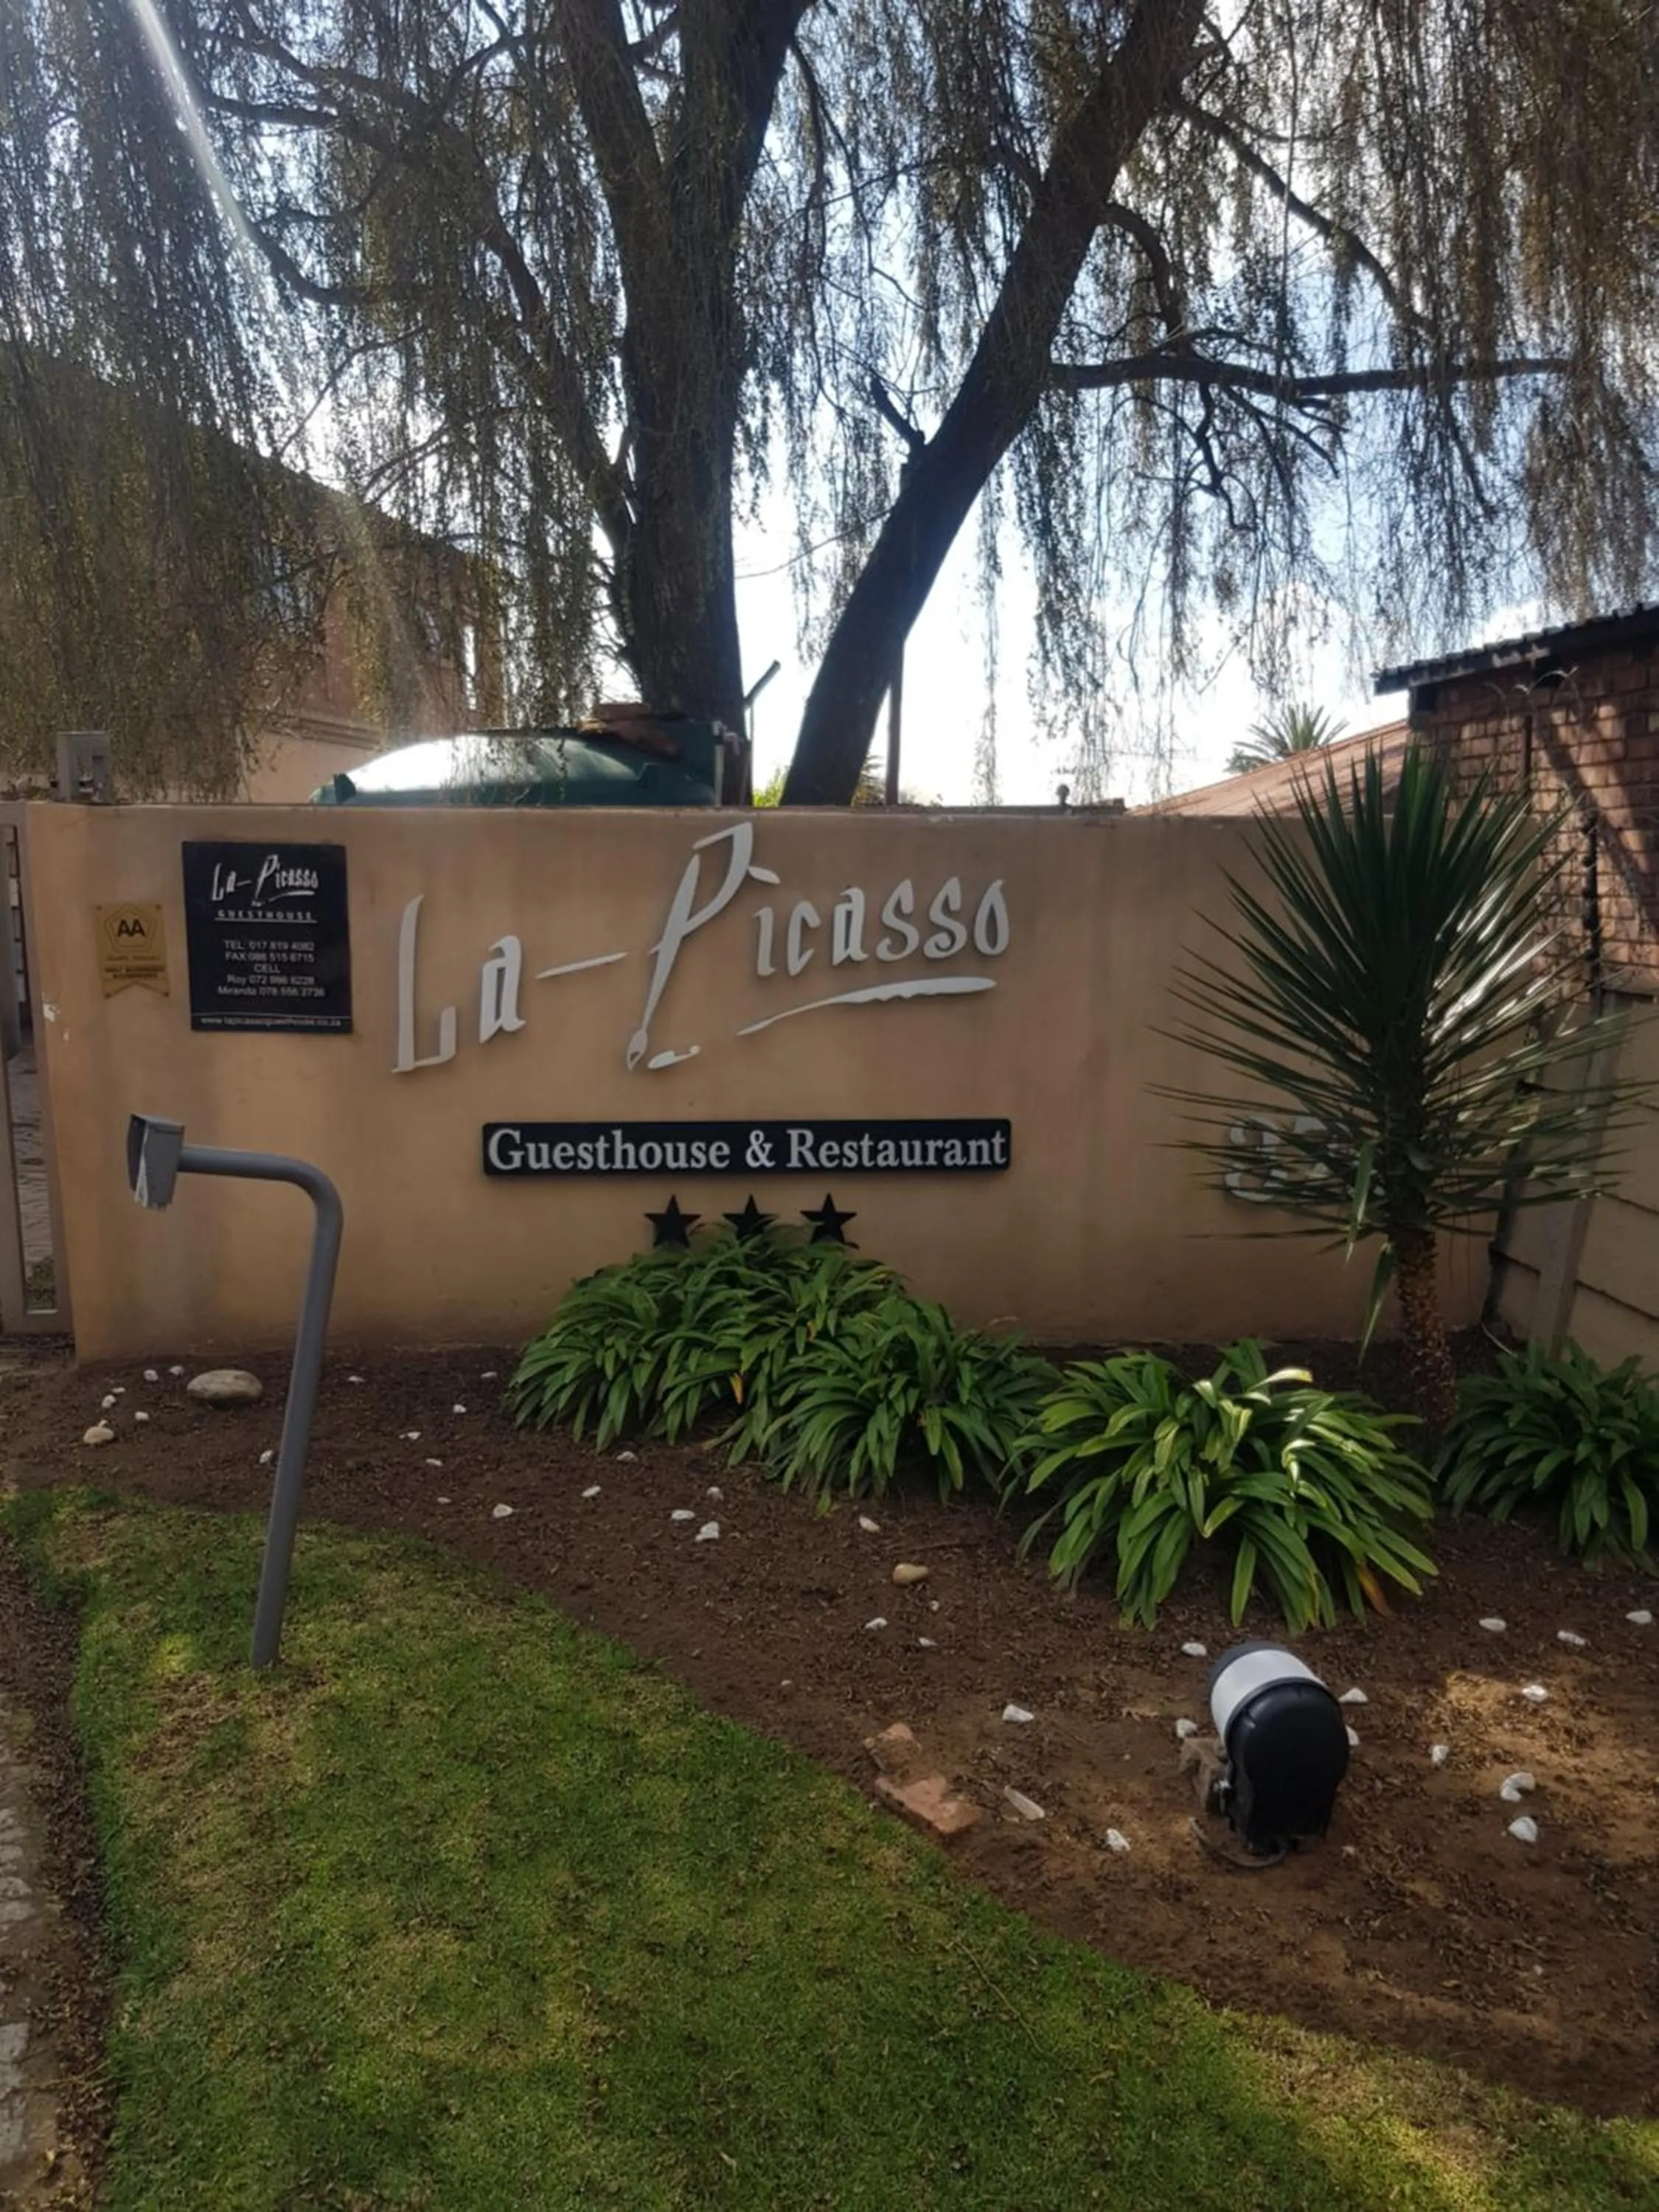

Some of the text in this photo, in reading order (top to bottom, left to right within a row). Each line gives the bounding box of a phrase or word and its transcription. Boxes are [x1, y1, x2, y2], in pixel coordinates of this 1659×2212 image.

[218, 909, 313, 920] GUESTHOUSE
[117, 919, 146, 938] AA
[248, 941, 267, 950] 017
[254, 964, 281, 973] CELL
[218, 986, 257, 995] Miranda
[487, 1129, 1007, 1171] Guesthouse & Restaurant
